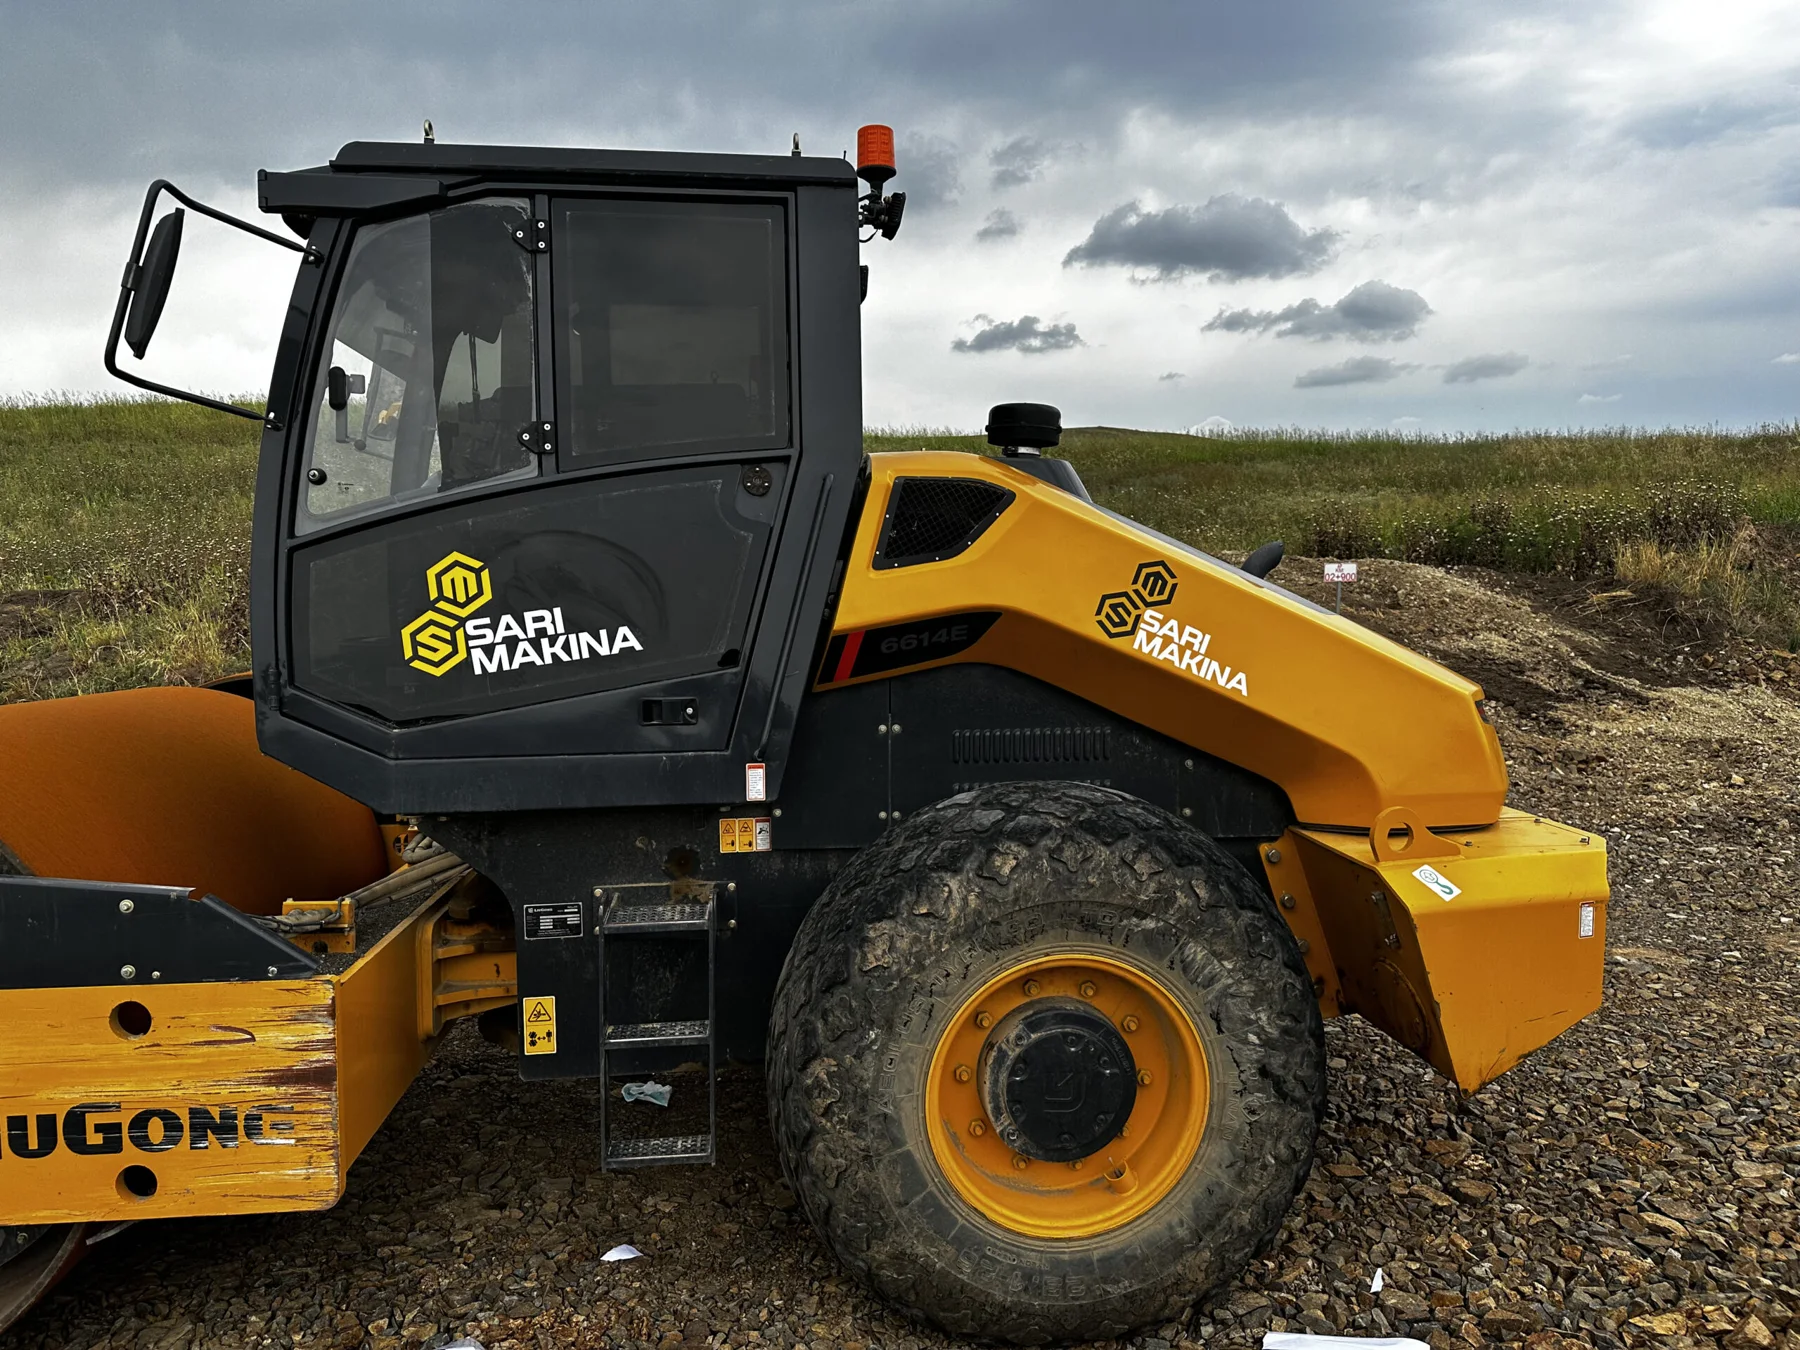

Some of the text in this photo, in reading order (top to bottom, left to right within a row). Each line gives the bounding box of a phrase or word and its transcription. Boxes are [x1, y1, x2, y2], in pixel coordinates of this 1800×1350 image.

[1324, 572, 1356, 582] 02+900
[464, 606, 565, 647] SARI
[880, 624, 969, 654] 6614E
[1139, 609, 1211, 655] SARI
[470, 625, 644, 676] MAKINA
[1132, 628, 1248, 697] MAKINA
[0, 1101, 297, 1160] UGONG
